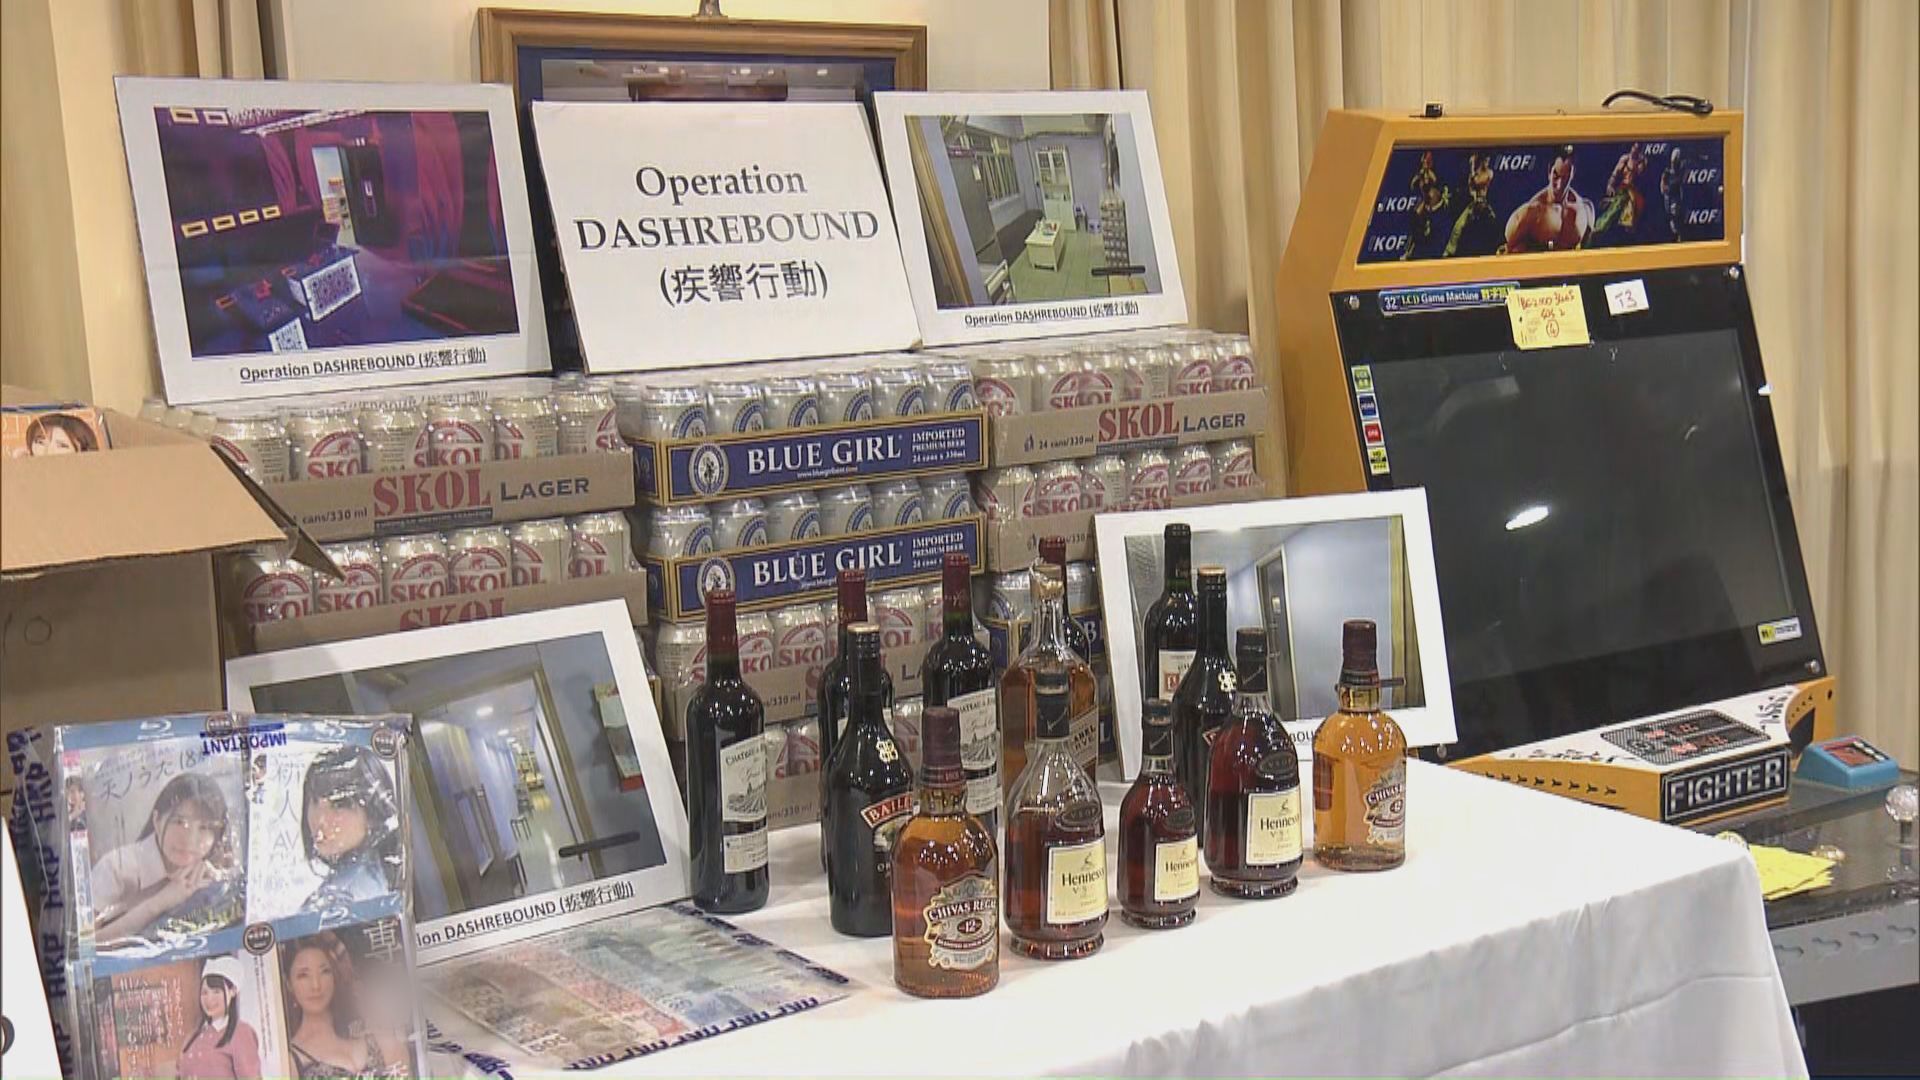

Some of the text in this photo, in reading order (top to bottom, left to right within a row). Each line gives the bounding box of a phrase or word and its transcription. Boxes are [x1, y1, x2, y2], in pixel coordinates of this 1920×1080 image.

[1645, 142, 1667, 155] KOF
[1500, 155, 1531, 170] KOF
[636, 164, 808, 206] Operation
[1688, 169, 1717, 184] KOF
[1385, 197, 1416, 211] KOF
[1689, 209, 1718, 224] KOF
[573, 211, 879, 250] DASHREBOUND
[1373, 235, 1406, 252] KOF
[660, 261, 829, 307] (疾響行動)
[1421, 293, 1445, 304] Game
[1446, 290, 1479, 303] Machine
[965, 311, 1013, 326] Operation
[1014, 305, 1087, 323] DASHREBOUND
[239, 363, 309, 383] Operation
[313, 354, 416, 372] DASHREBOUND
[1099, 402, 1245, 442] SKOL LAGER
[912, 427, 966, 442] IMPORTED
[748, 434, 902, 475] BLUE GIRL
[912, 440, 946, 452] PREMIUM
[373, 469, 589, 519] SKOL LAGER
[353, 508, 368, 519] ml
[912, 532, 964, 548] IMPORTED
[912, 544, 946, 557] PREMIUM
[753, 543, 902, 587] BLUE GIRL
[779, 647, 823, 666] SKO
[201, 731, 287, 756] IMPORTANT
[1668, 759, 1783, 812] FIGHTER
[445, 901, 557, 941] DASHREBOUND
[929, 902, 971, 922] CHIVAS
[965, 920, 976, 932] 12
[45, 933, 67, 998] HKP
